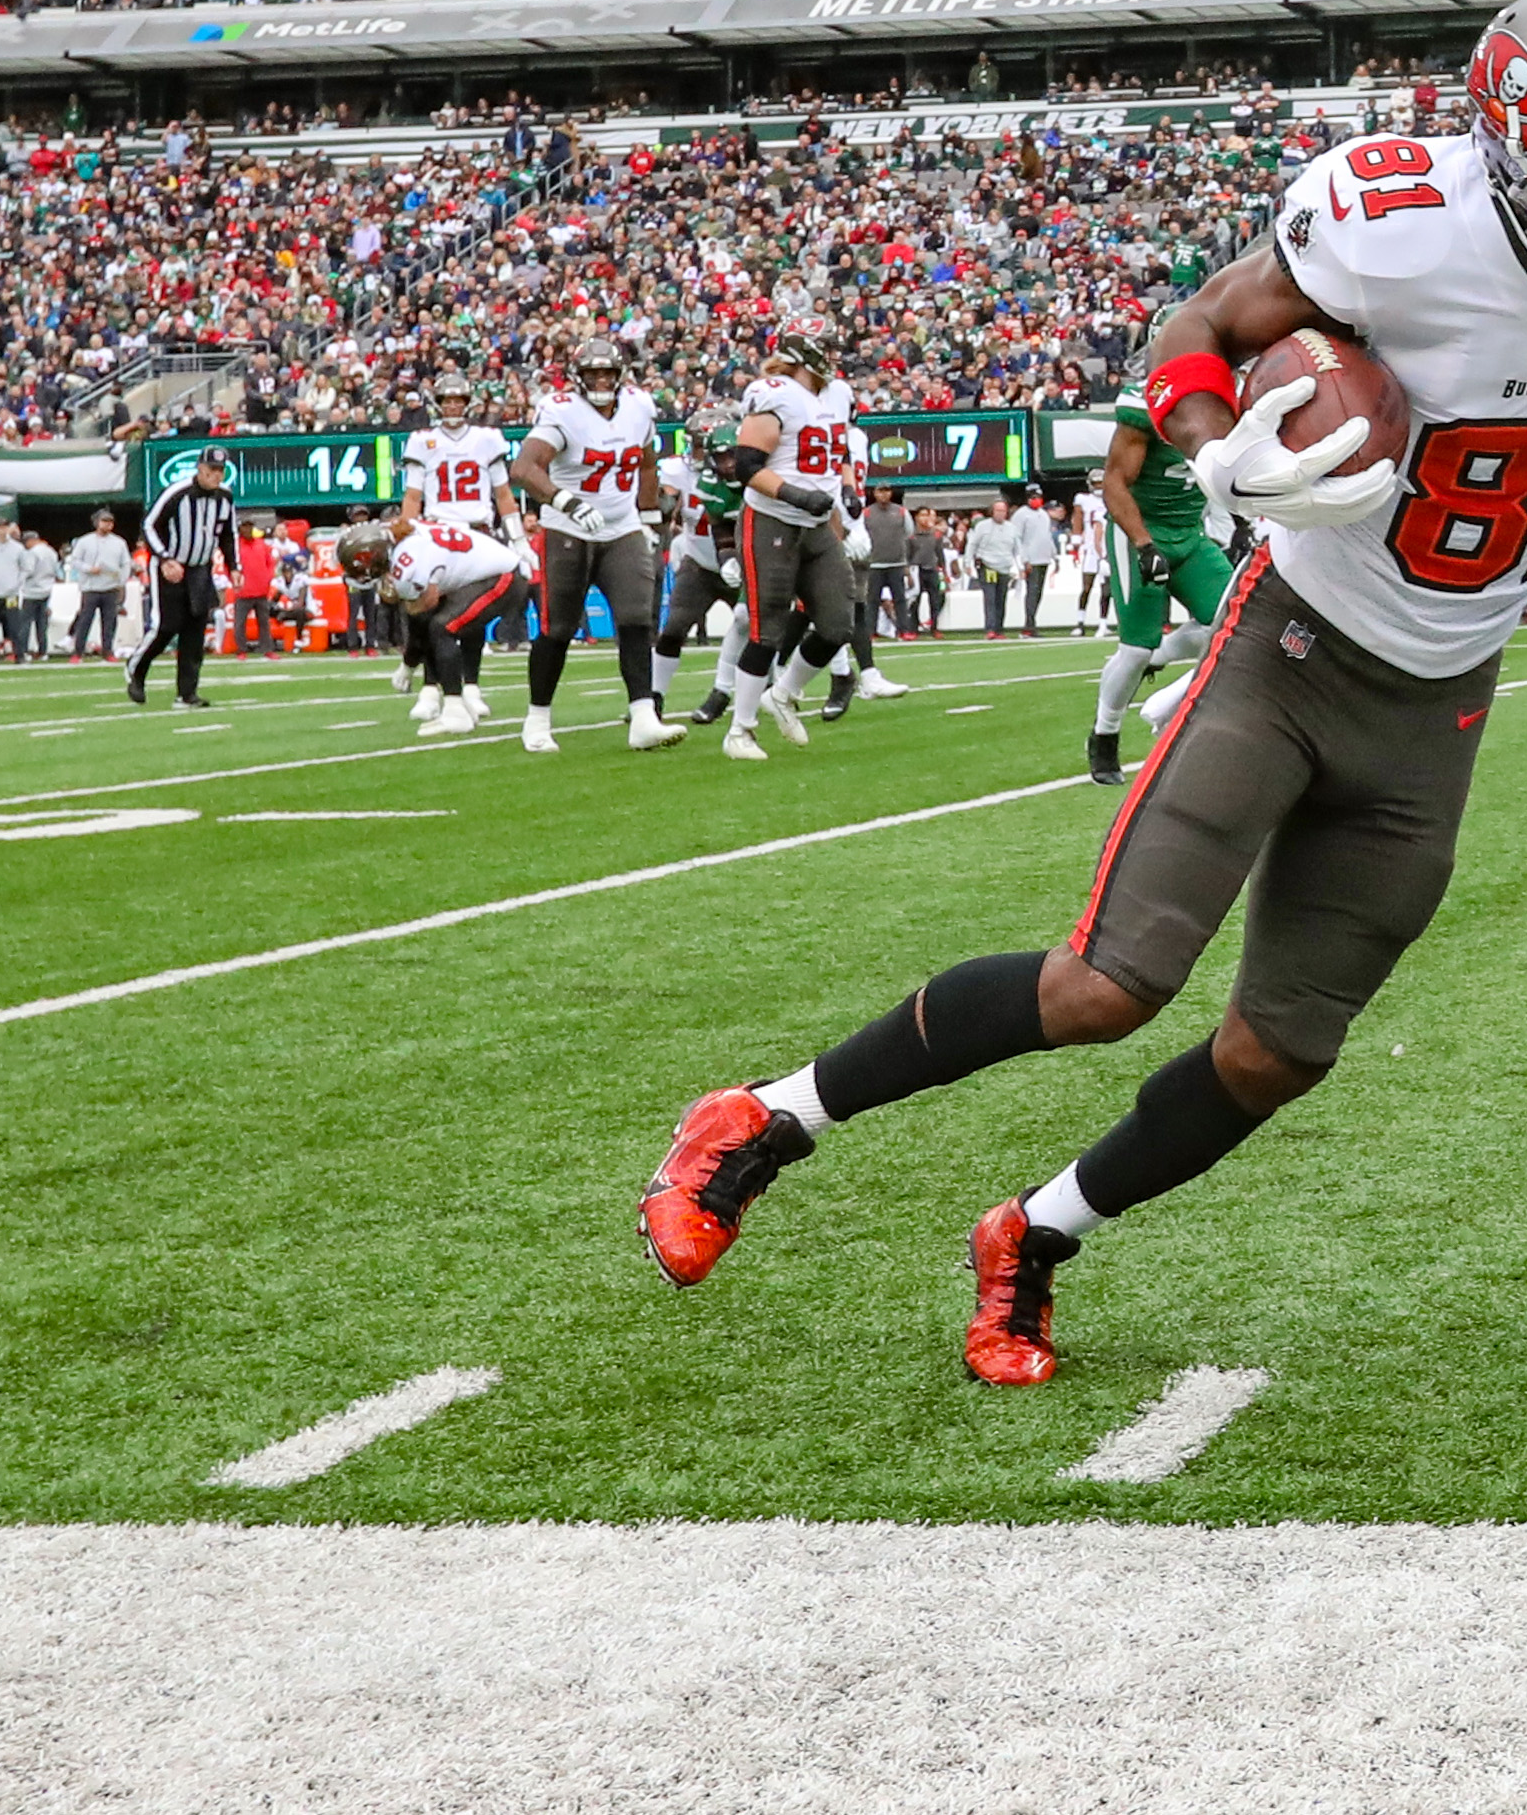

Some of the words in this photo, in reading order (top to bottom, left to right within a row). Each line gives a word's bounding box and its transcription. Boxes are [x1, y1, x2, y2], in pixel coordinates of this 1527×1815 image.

[253, 16, 407, 39] MetLife
[923, 112, 1030, 135] YORK
[1345, 140, 1447, 222] 81
[308, 445, 368, 493] 14
[579, 444, 644, 493] 78
[796, 423, 848, 476] 65
[945, 424, 980, 471] 7
[435, 460, 481, 503] 12
